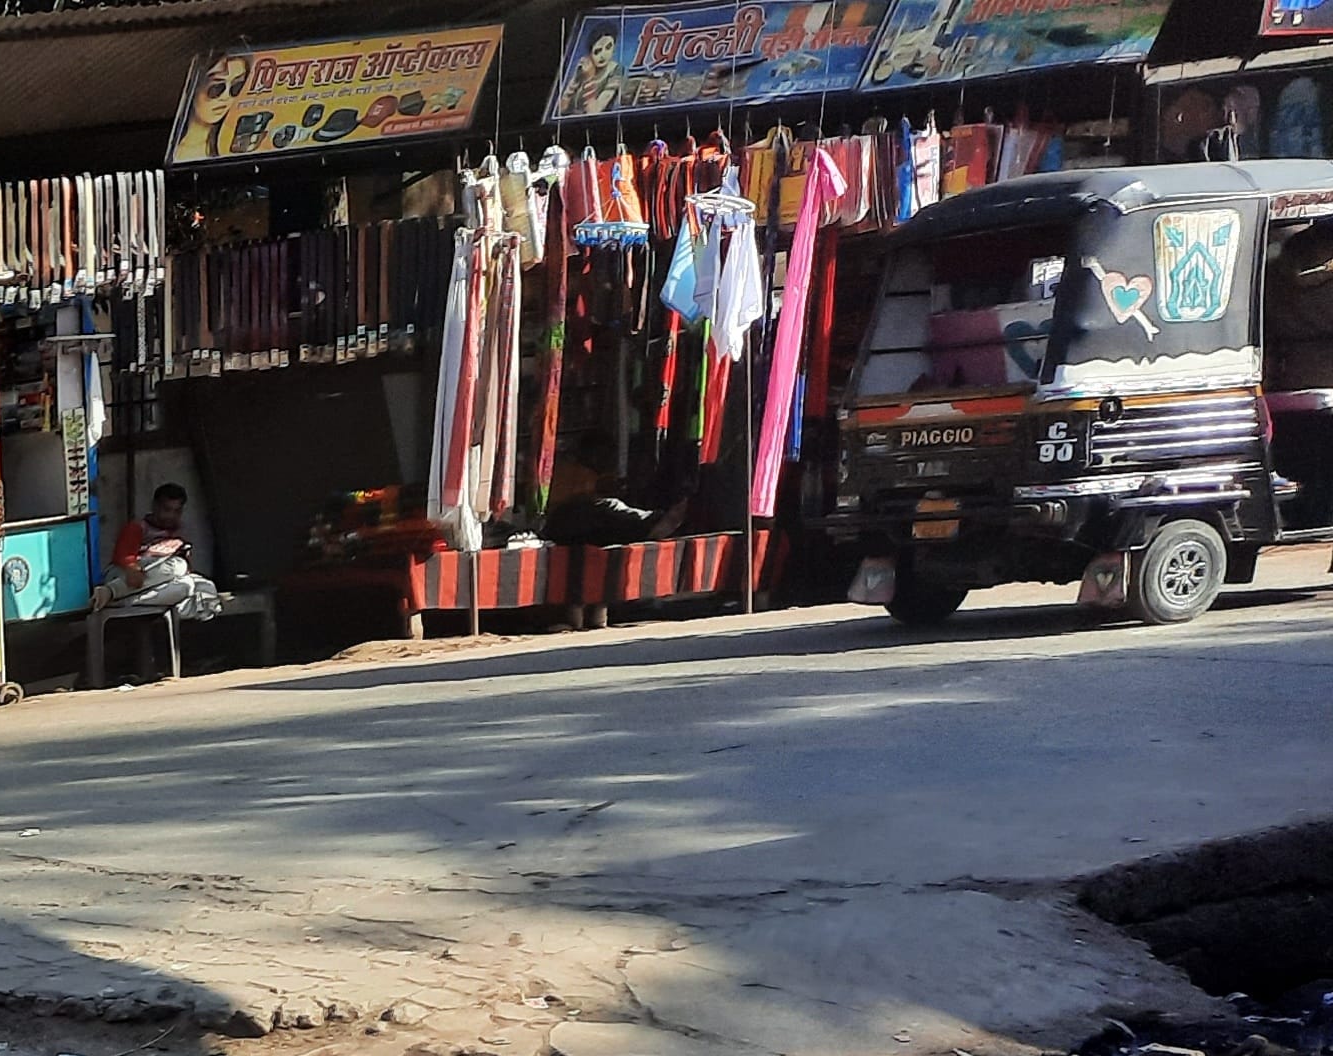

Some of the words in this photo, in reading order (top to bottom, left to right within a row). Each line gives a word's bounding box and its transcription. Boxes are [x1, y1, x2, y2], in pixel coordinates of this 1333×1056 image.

[900, 427, 974, 447] PIAGGIO
[1048, 421, 1068, 440] C
[1039, 443, 1075, 462] 90
